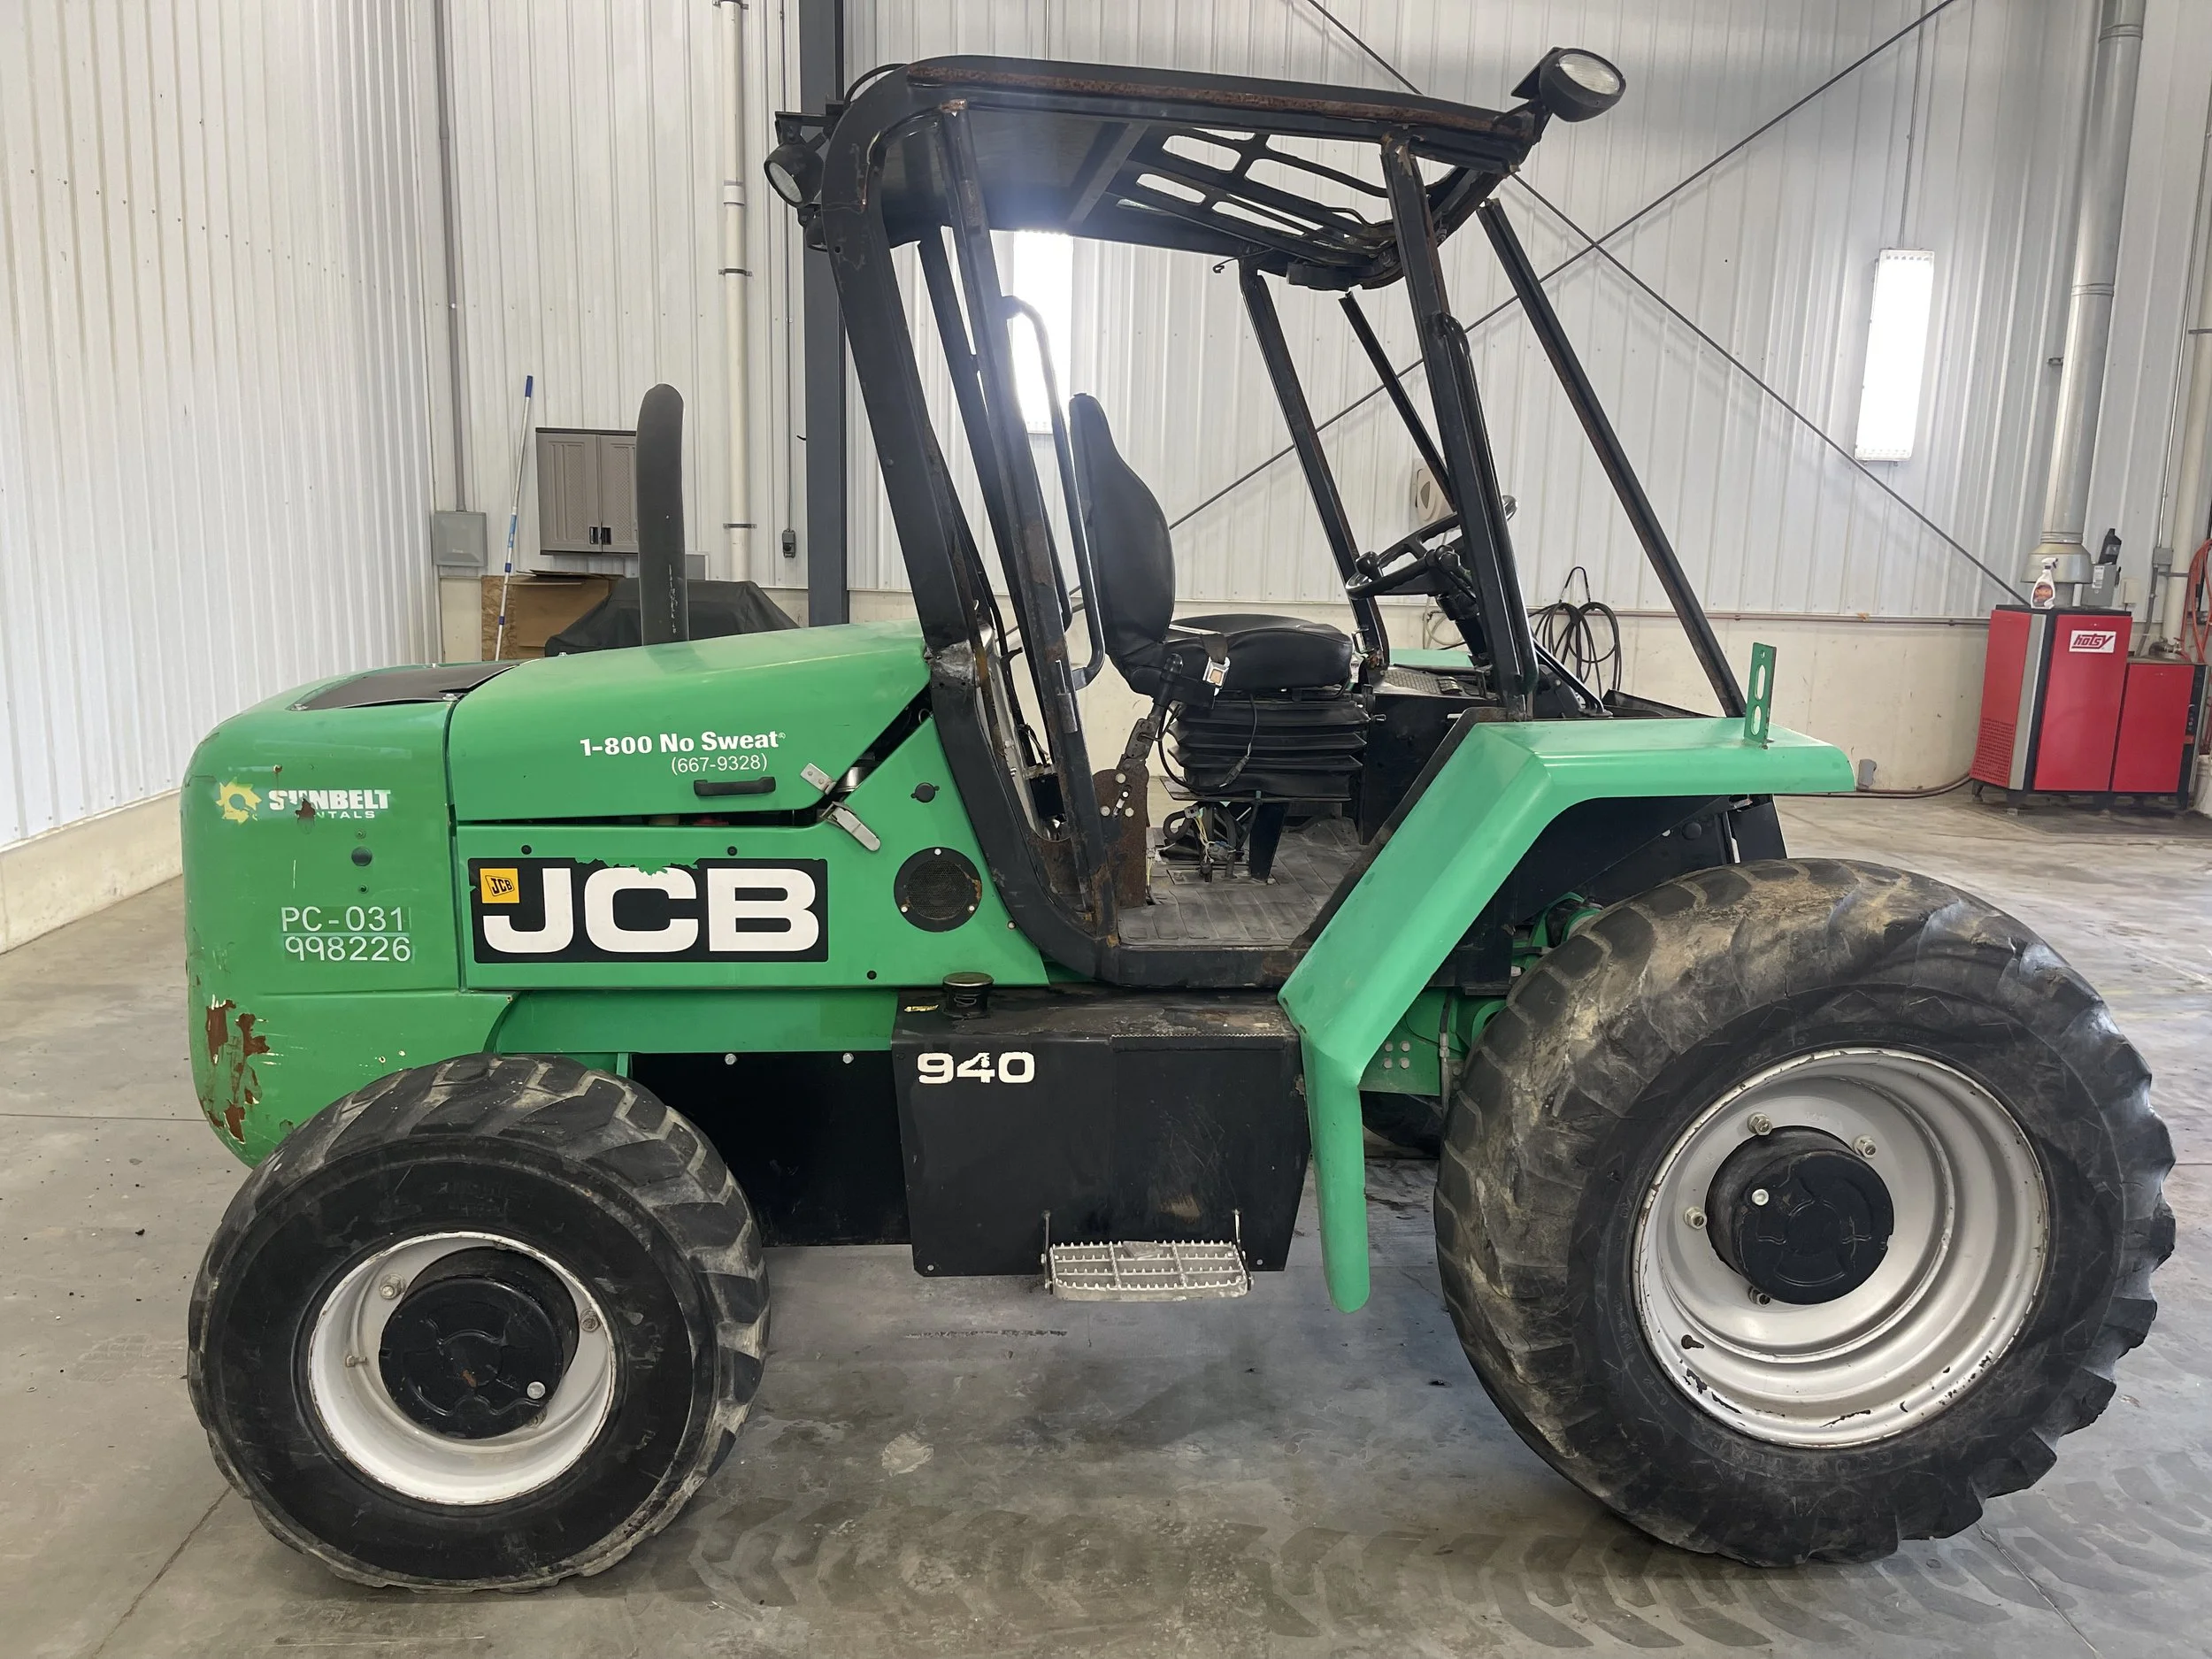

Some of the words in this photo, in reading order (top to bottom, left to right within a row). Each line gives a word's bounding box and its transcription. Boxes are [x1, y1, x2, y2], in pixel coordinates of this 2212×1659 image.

[580, 736, 653, 757] 1-800
[659, 733, 695, 753] No
[671, 753, 768, 776] (667-9328)
[490, 877, 513, 895] JCB
[482, 867, 819, 953] JCB
[285, 936, 411, 962] 998226
[917, 1051, 1035, 1085] 940
